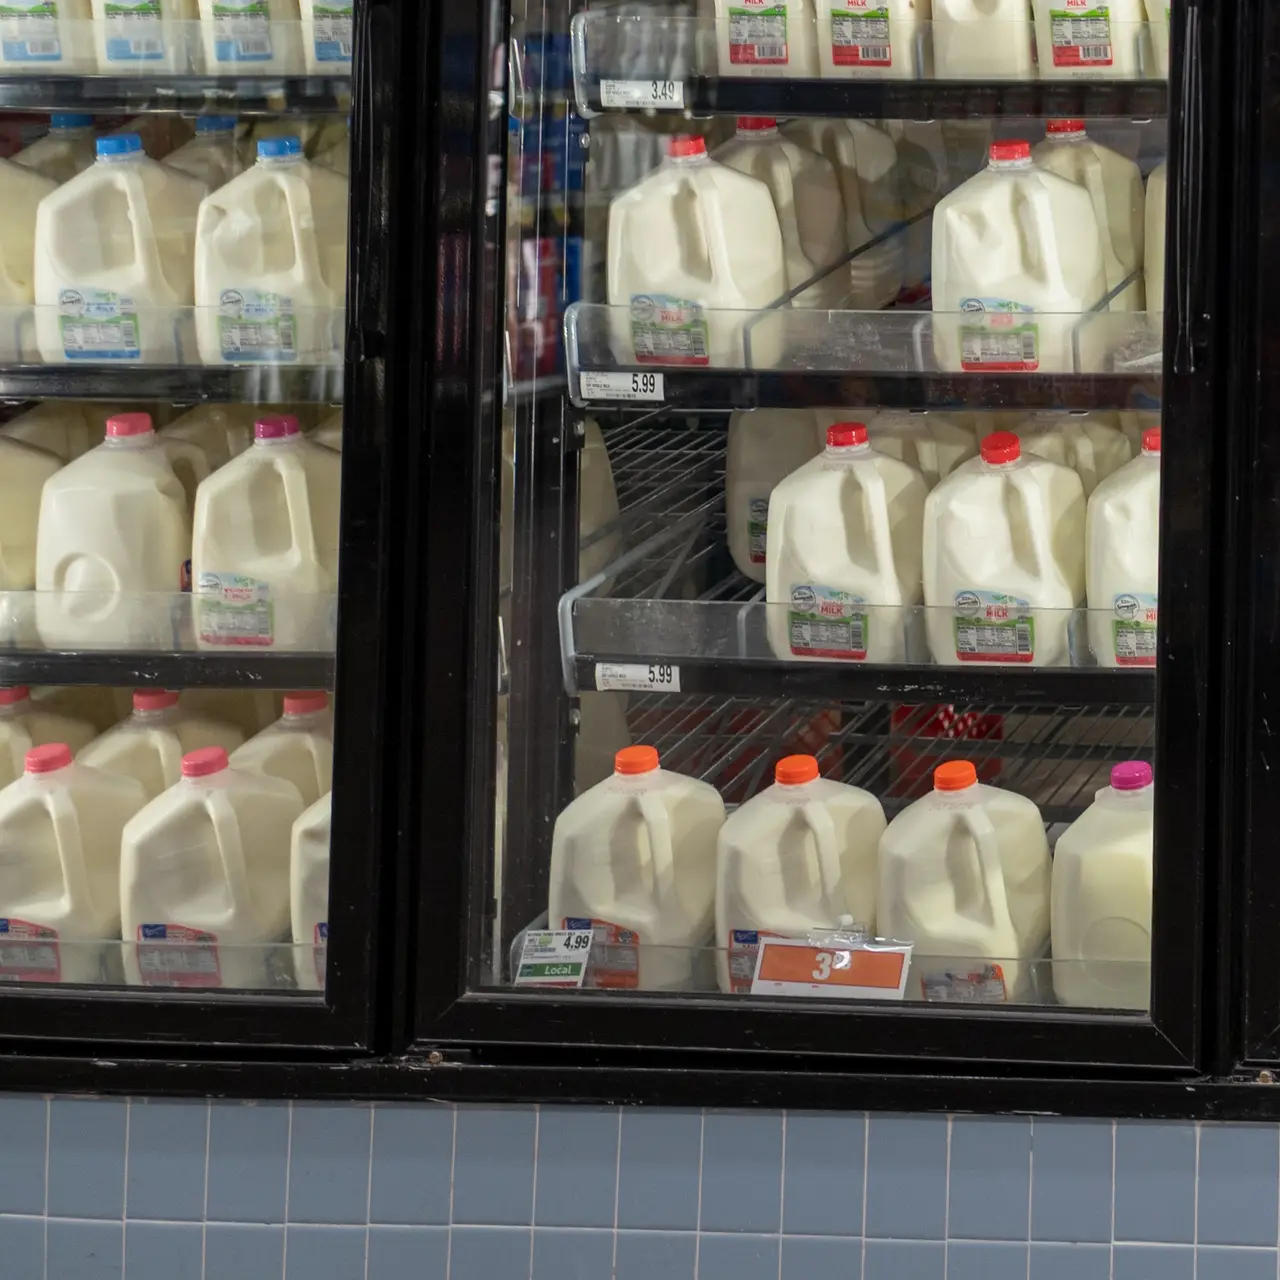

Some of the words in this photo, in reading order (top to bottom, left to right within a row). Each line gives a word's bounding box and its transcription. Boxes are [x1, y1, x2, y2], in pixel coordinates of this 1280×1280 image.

[652, 82, 674, 100] 3.49
[632, 374, 655, 394] 5.99
[821, 607, 842, 615] MILK
[648, 665, 672, 684] 5.99
[564, 935, 589, 950] 4.99
[545, 965, 572, 975] Local
